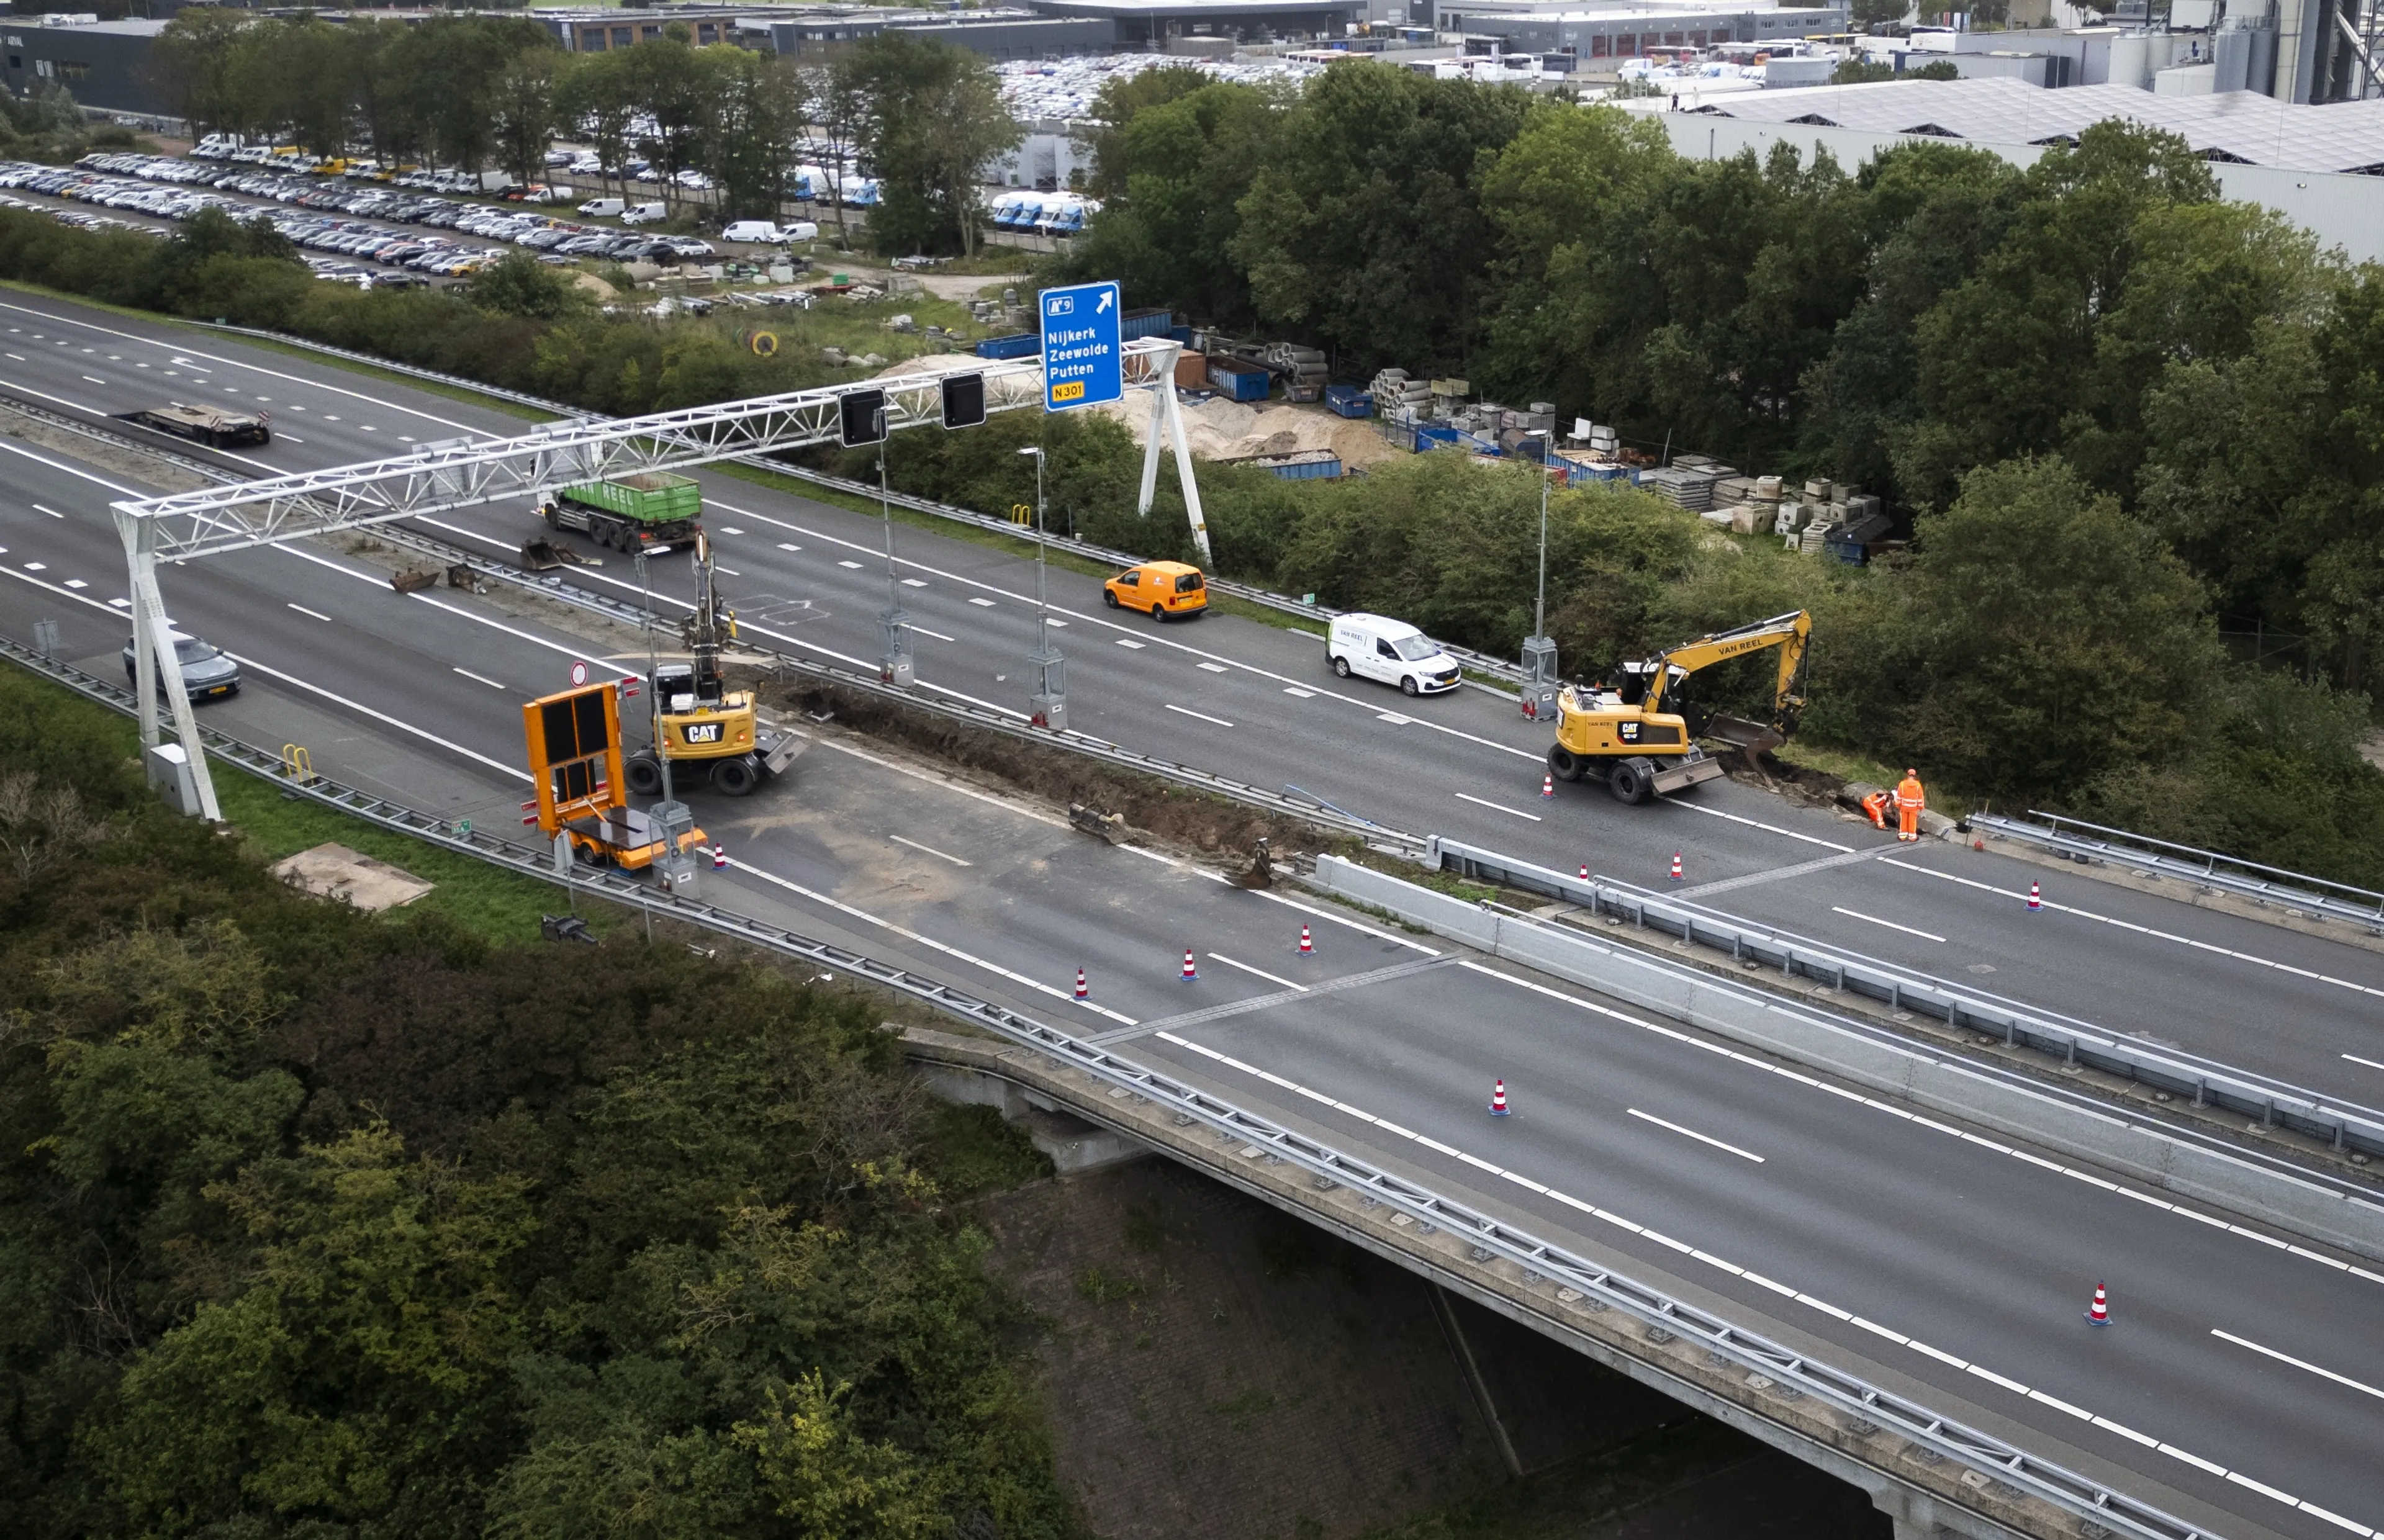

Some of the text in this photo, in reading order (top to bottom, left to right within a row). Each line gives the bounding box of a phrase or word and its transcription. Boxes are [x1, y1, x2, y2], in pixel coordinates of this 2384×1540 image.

[1063, 300, 1070, 310] 9
[1048, 327, 1096, 346] Nijkerk
[1049, 343, 1109, 362] Zeewolde
[1050, 363, 1094, 379] Putten
[602, 485, 634, 506] REEL
[1718, 639, 1763, 655] VAN REEL
[689, 725, 717, 743] CAT
[1622, 723, 1638, 733] CAT
